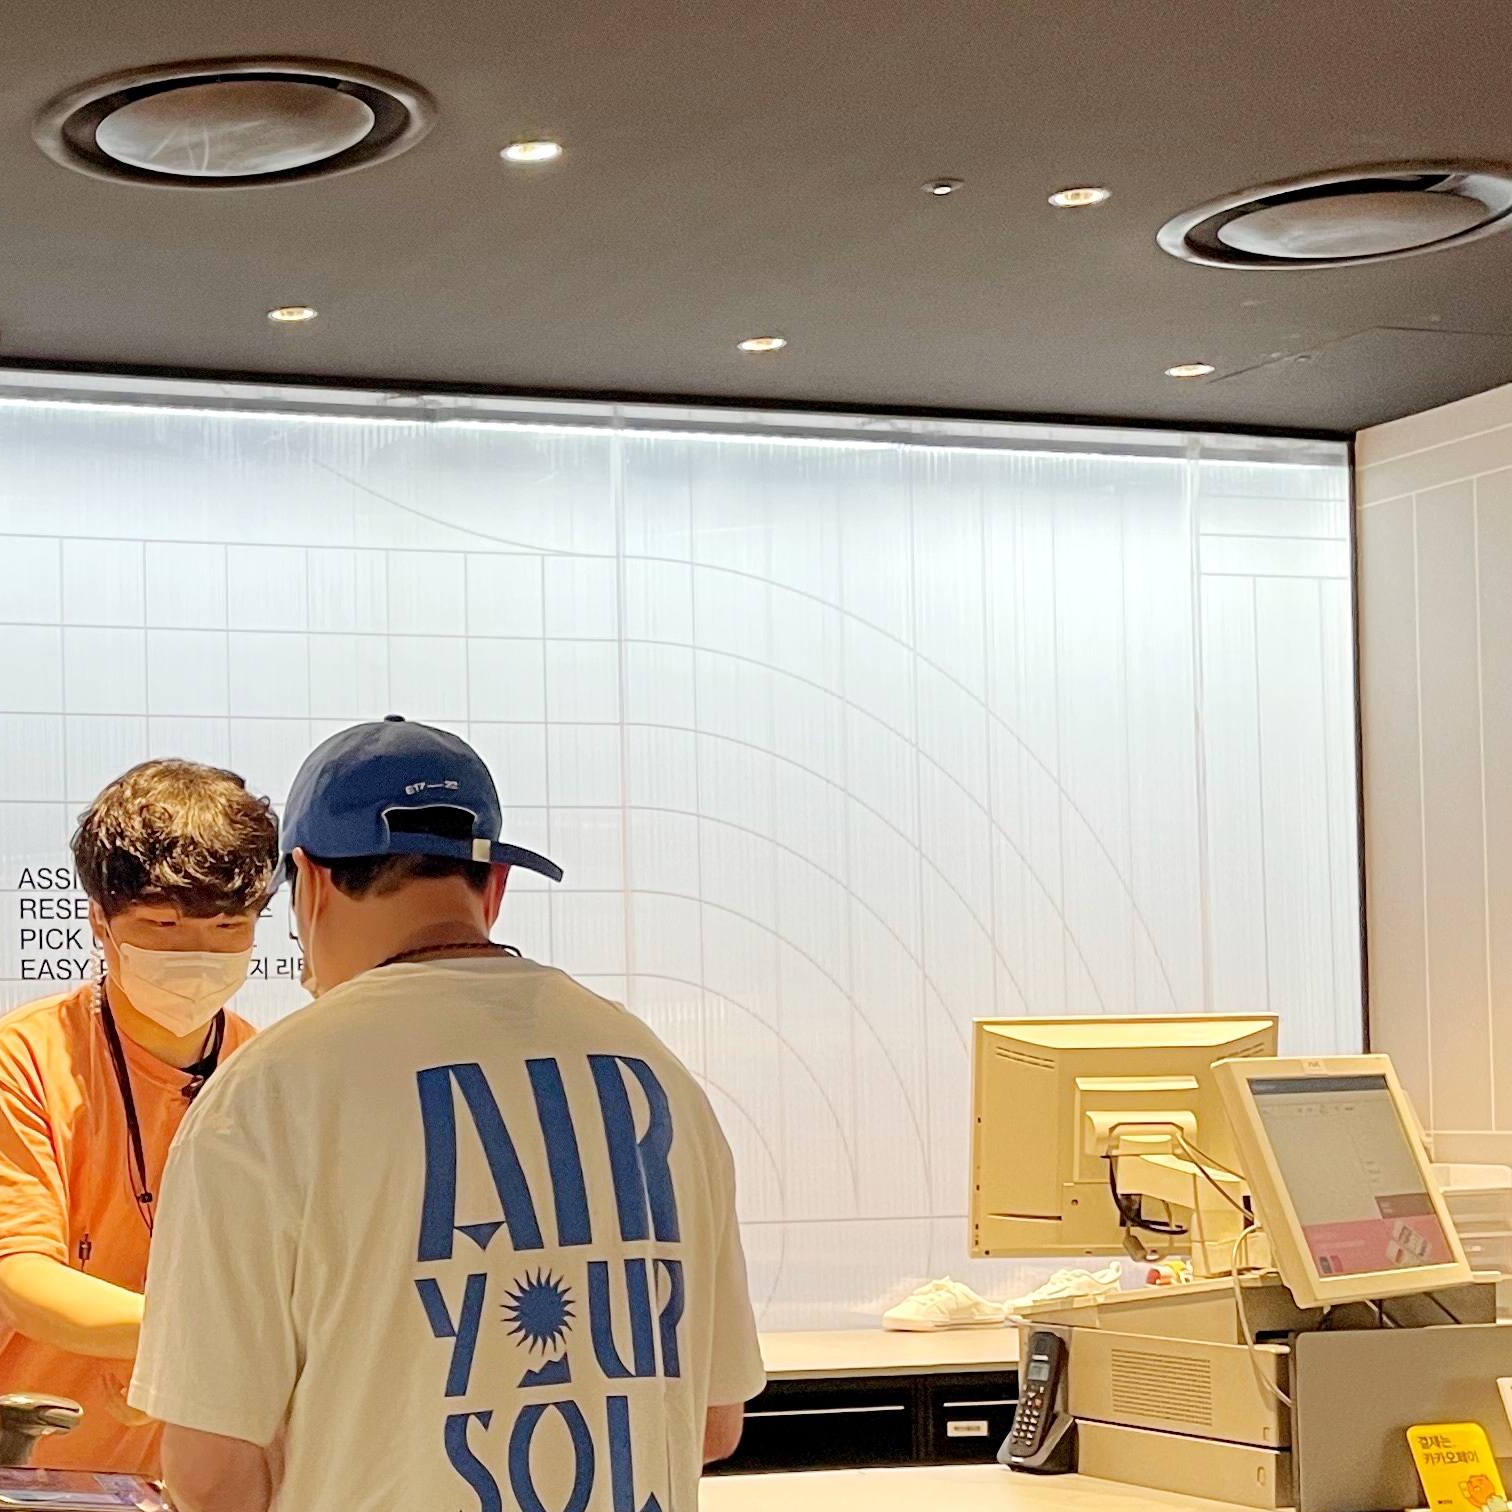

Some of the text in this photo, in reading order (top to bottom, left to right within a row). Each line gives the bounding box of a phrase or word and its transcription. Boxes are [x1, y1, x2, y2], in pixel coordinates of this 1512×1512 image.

[18, 867, 78, 890] ASSI
[20, 898, 88, 919] RESE
[20, 928, 83, 950] PICK
[21, 958, 90, 980] EASY
[416, 1054, 681, 1261] AIR
